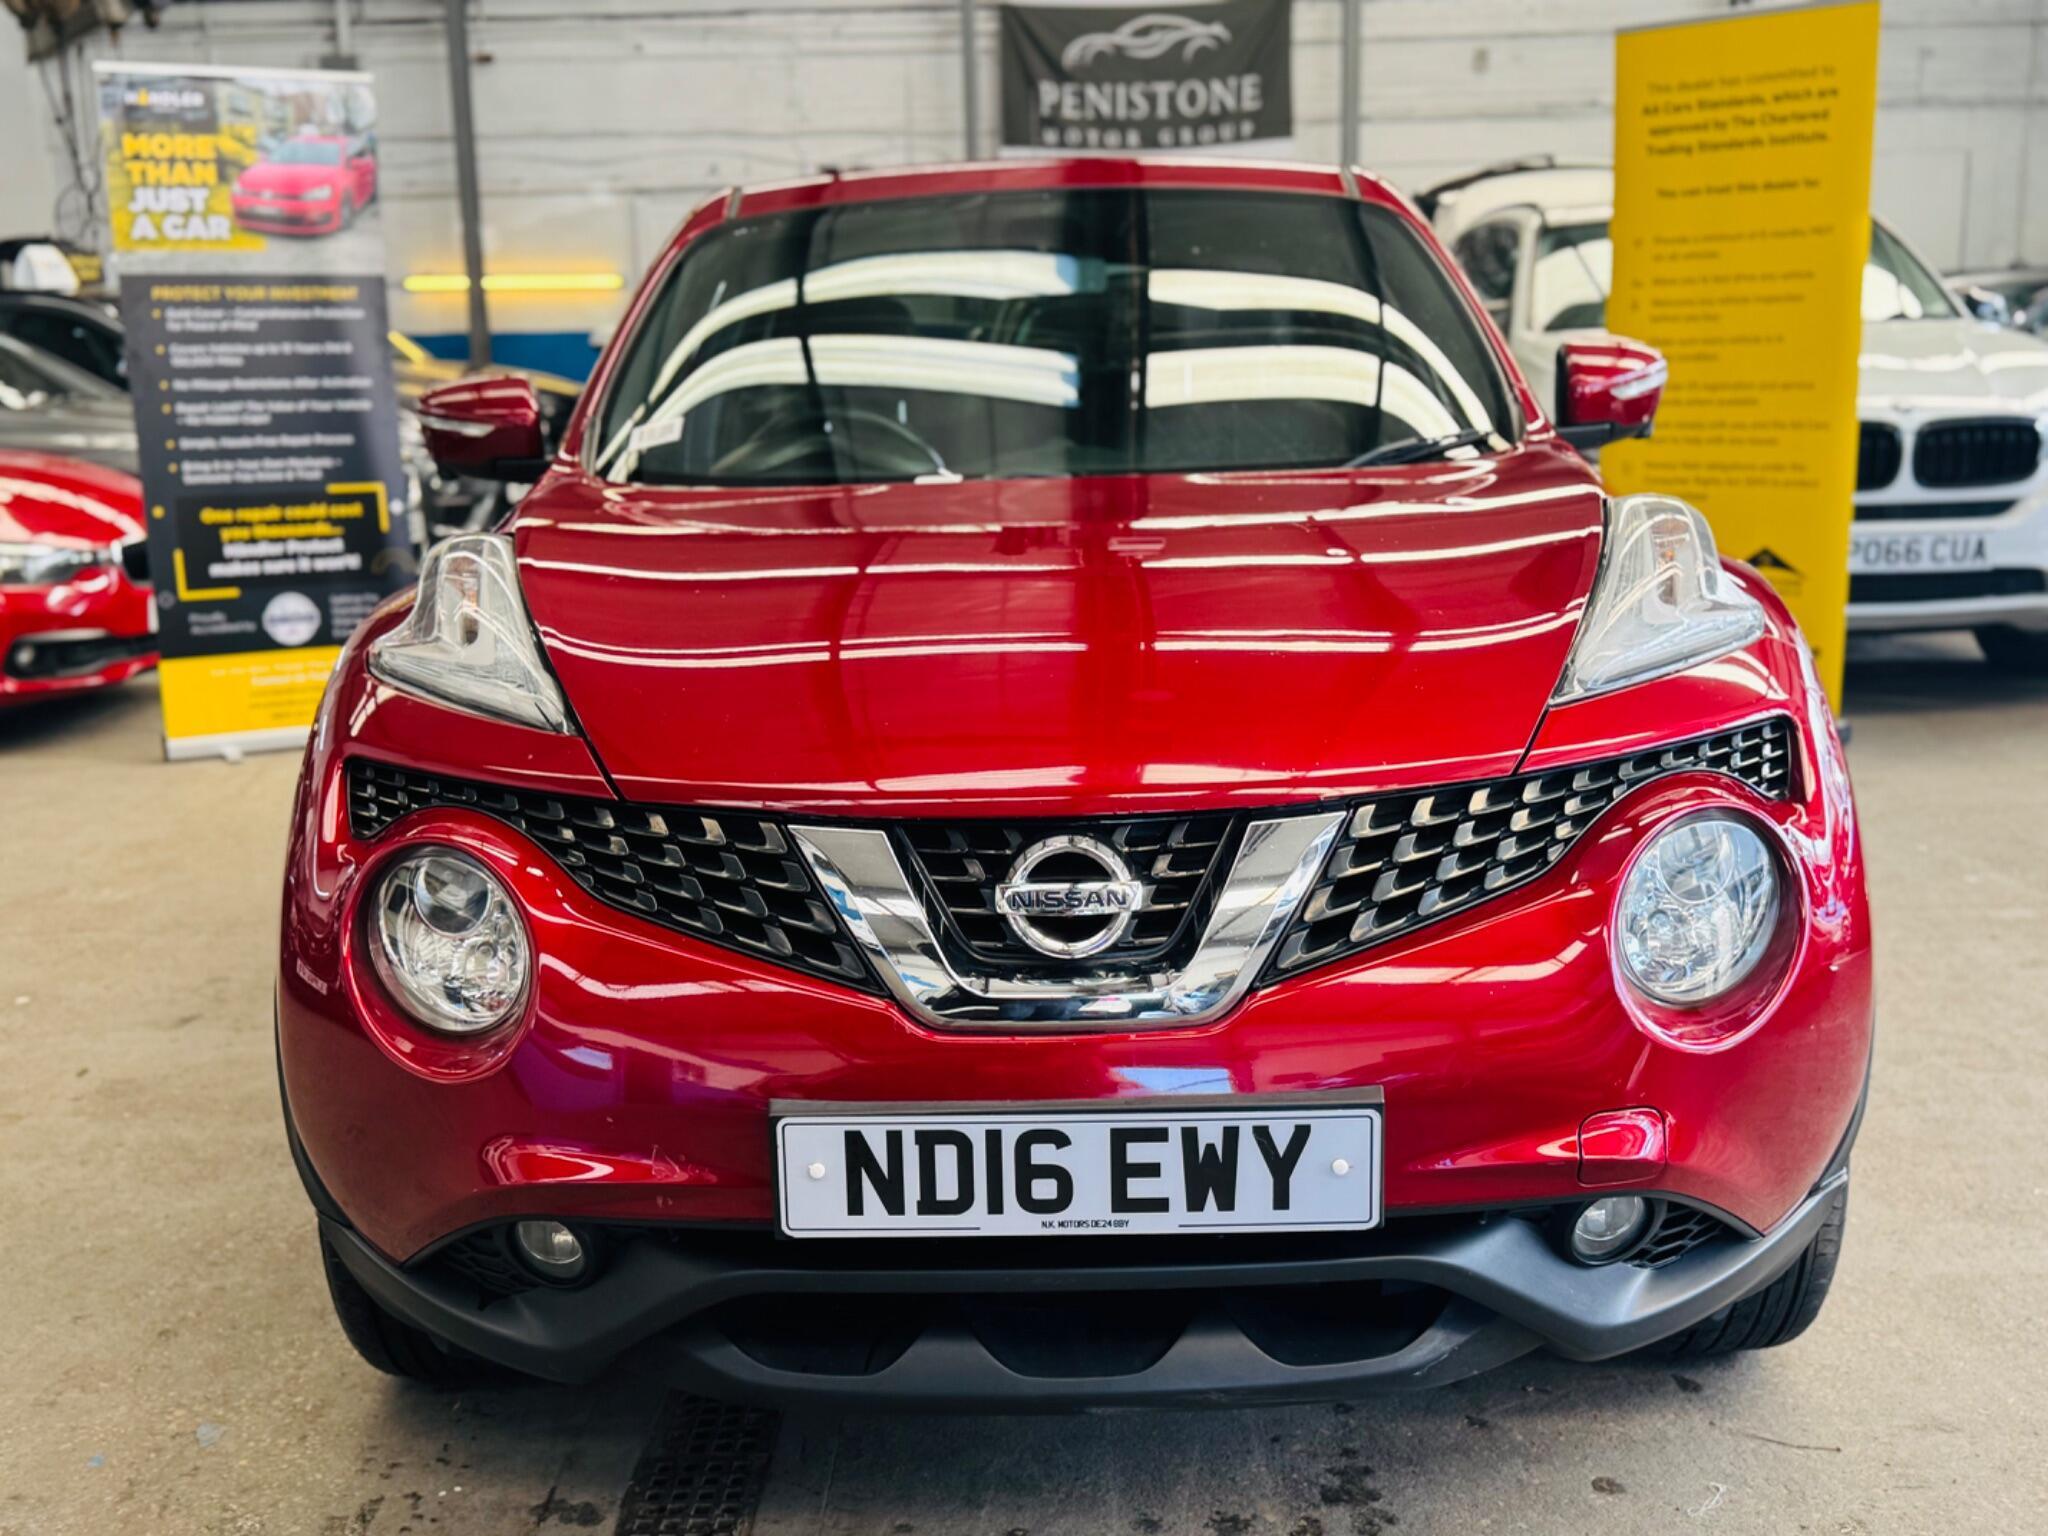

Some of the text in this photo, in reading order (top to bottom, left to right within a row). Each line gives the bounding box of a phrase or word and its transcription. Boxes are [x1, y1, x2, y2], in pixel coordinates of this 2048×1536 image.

[1038, 73, 1263, 121] PENISTONE
[121, 133, 218, 160] MORE
[1042, 126, 1143, 148] MOTOR
[124, 161, 218, 186] THAN
[128, 186, 210, 213] JUST
[130, 214, 232, 241] A CAR
[1929, 535, 1987, 563] CUA
[1011, 890, 1127, 907] NISSAN
[843, 1124, 1312, 1217] ND16 EWY
[1057, 1219, 1090, 1229] MOTORS
